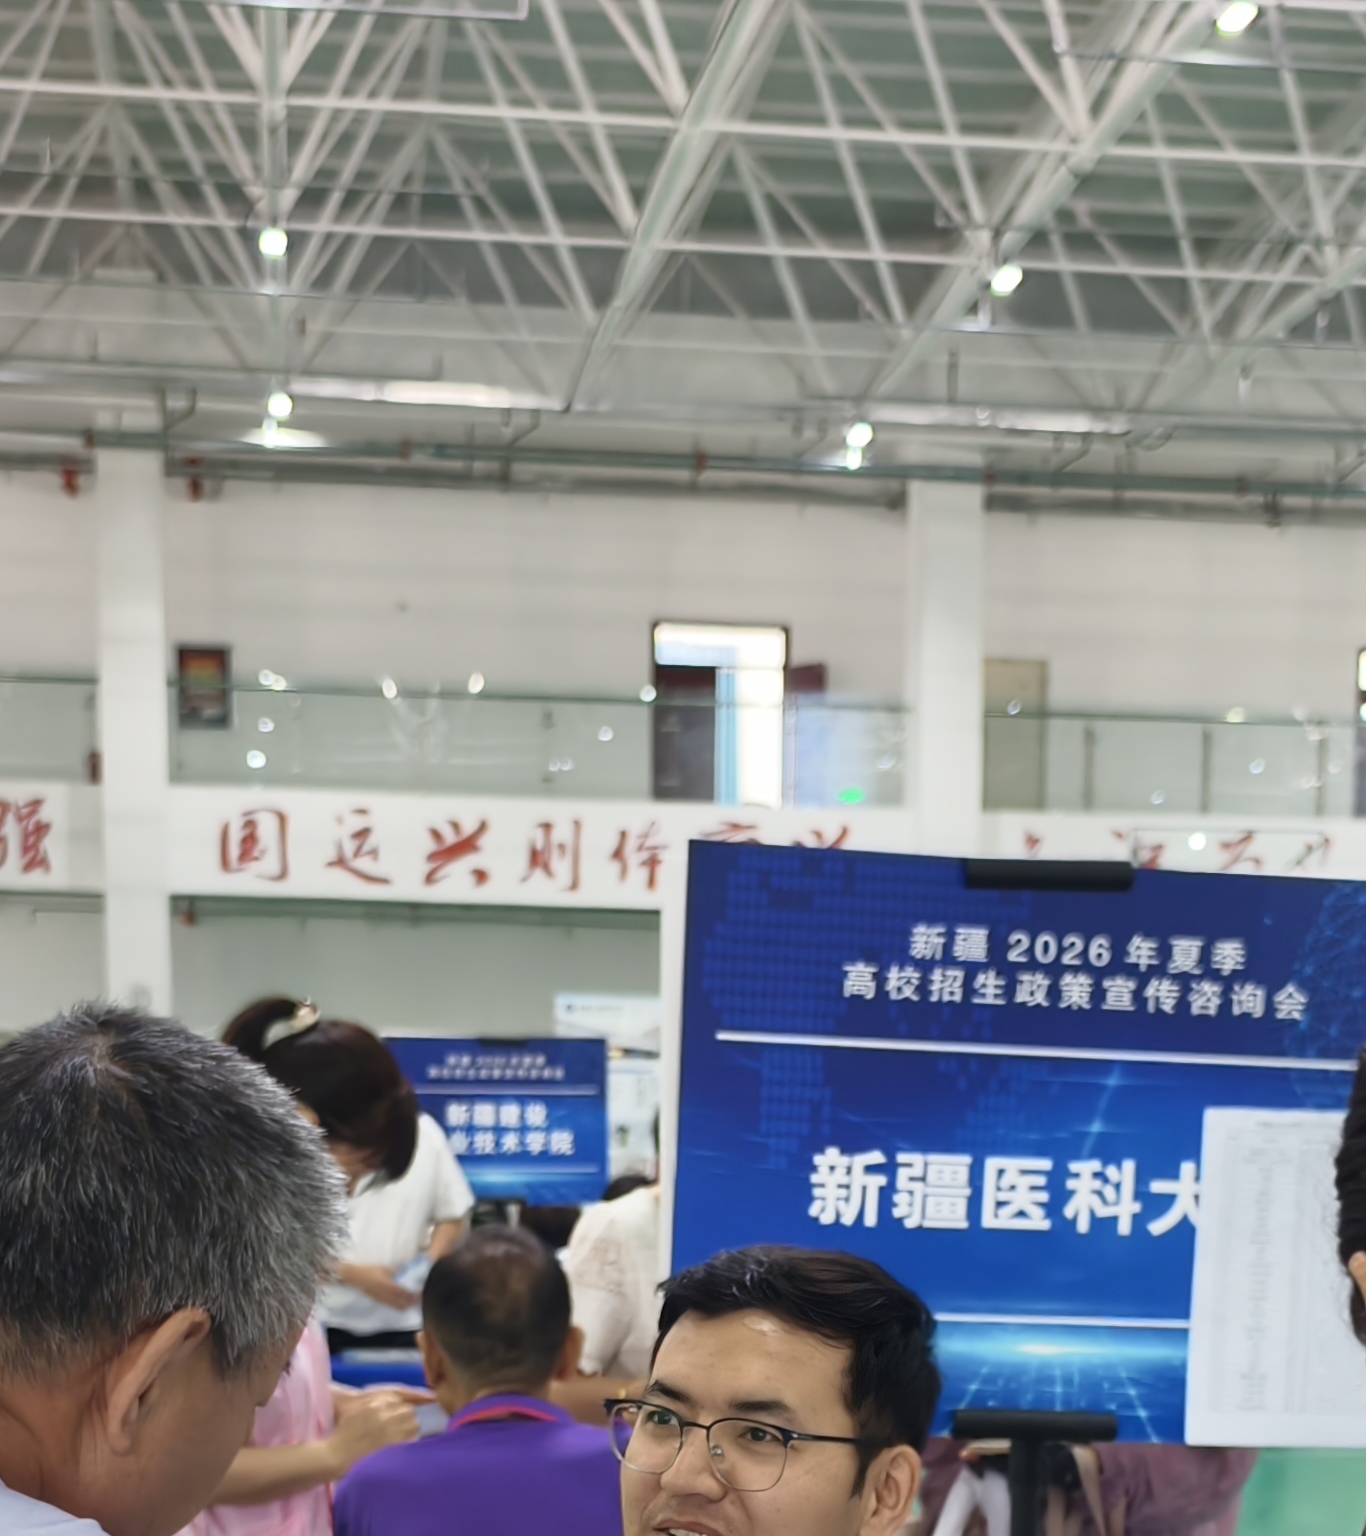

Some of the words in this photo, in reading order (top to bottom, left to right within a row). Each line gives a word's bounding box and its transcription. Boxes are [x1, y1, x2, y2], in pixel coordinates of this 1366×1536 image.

[909, 923, 990, 963] 新疆
[1006, 929, 1113, 967] 2026
[1124, 933, 1247, 977] 年夏季
[841, 960, 1309, 1021] 高校招生政策宣传咨询会
